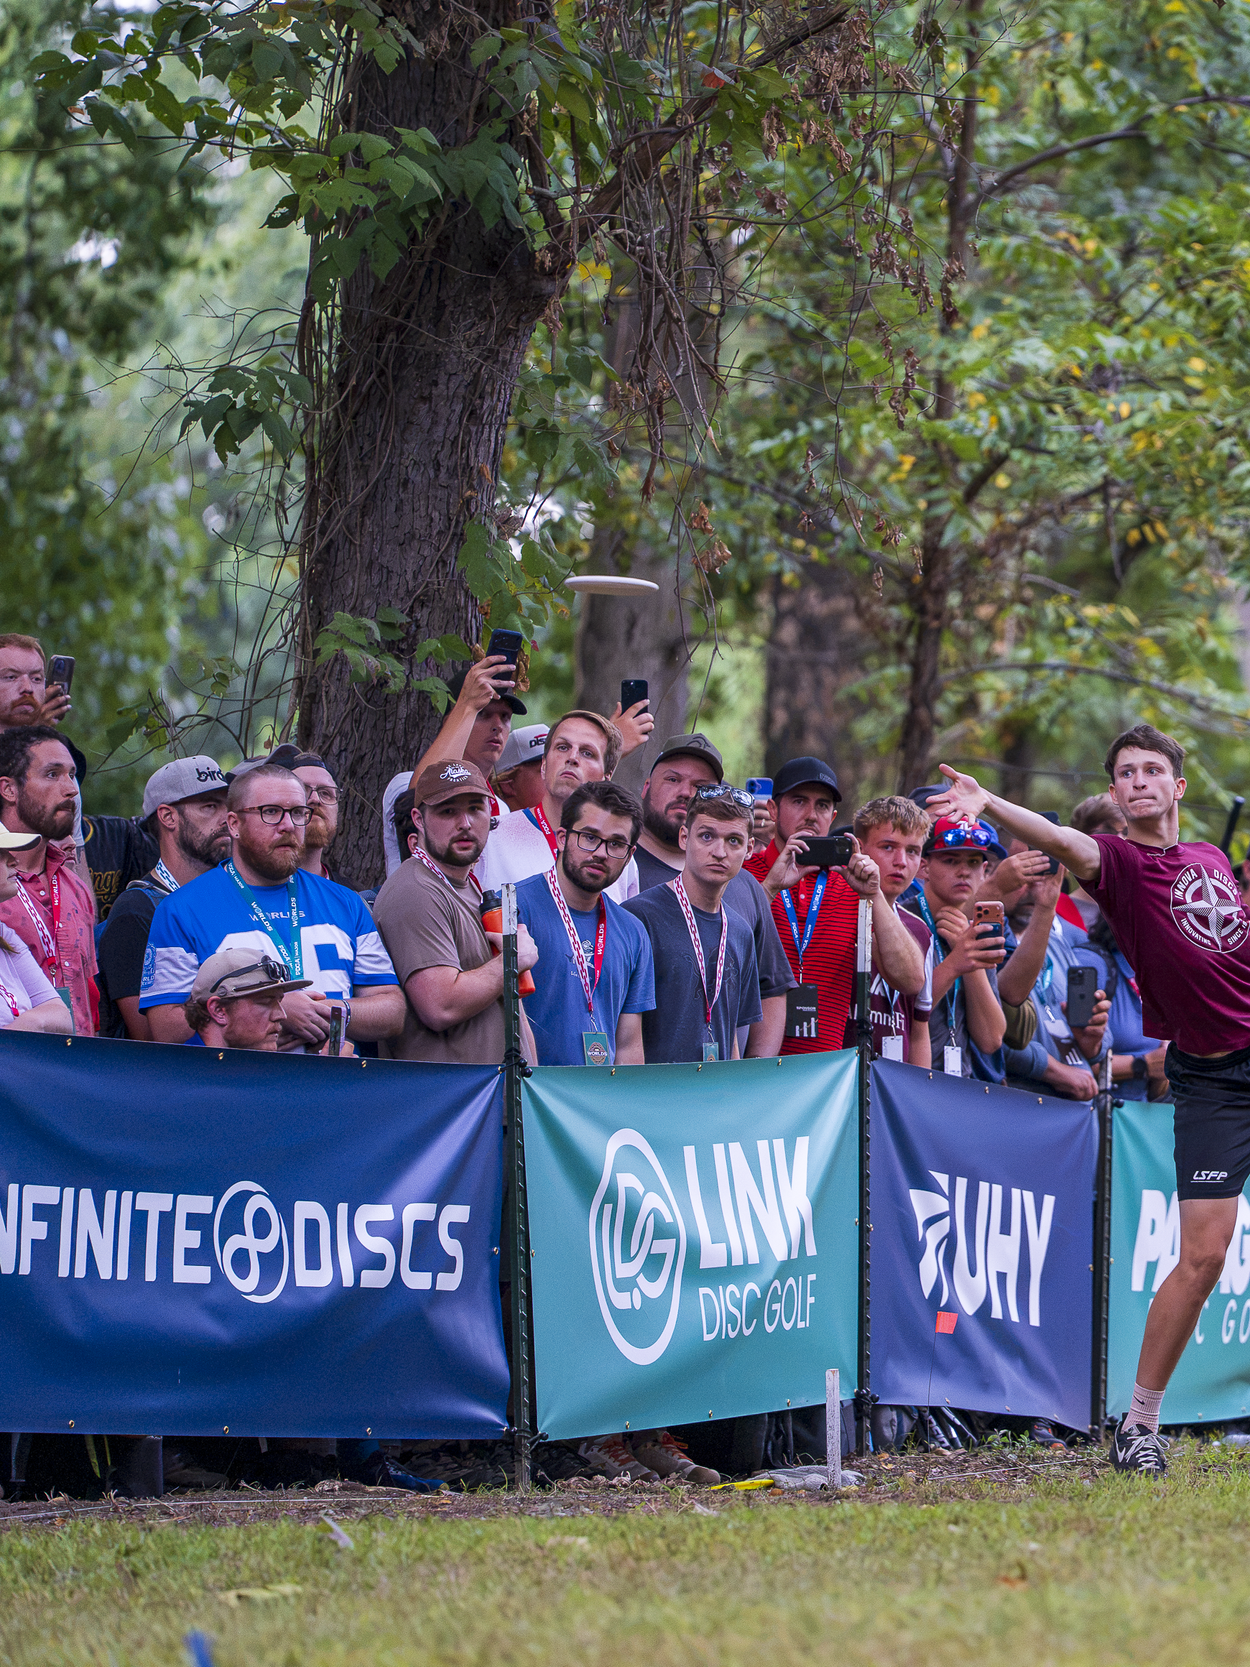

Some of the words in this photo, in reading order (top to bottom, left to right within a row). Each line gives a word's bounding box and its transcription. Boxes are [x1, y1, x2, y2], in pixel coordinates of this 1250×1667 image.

[810, 884, 824, 911] WORLDS
[1174, 868, 1198, 900] INNOVA
[251, 901, 273, 932] WORLDS
[1180, 917, 1212, 946] INNOVATING
[1227, 927, 1244, 946] SINCE
[596, 922, 606, 956] WORLDS
[1192, 1170, 1229, 1181] LSFP
[683, 1135, 818, 1269] LINK
[294, 1200, 471, 1291] DISCS
[953, 1176, 1056, 1328] UHY
[698, 1281, 762, 1343] DISC
[763, 1273, 817, 1334] GOLF
